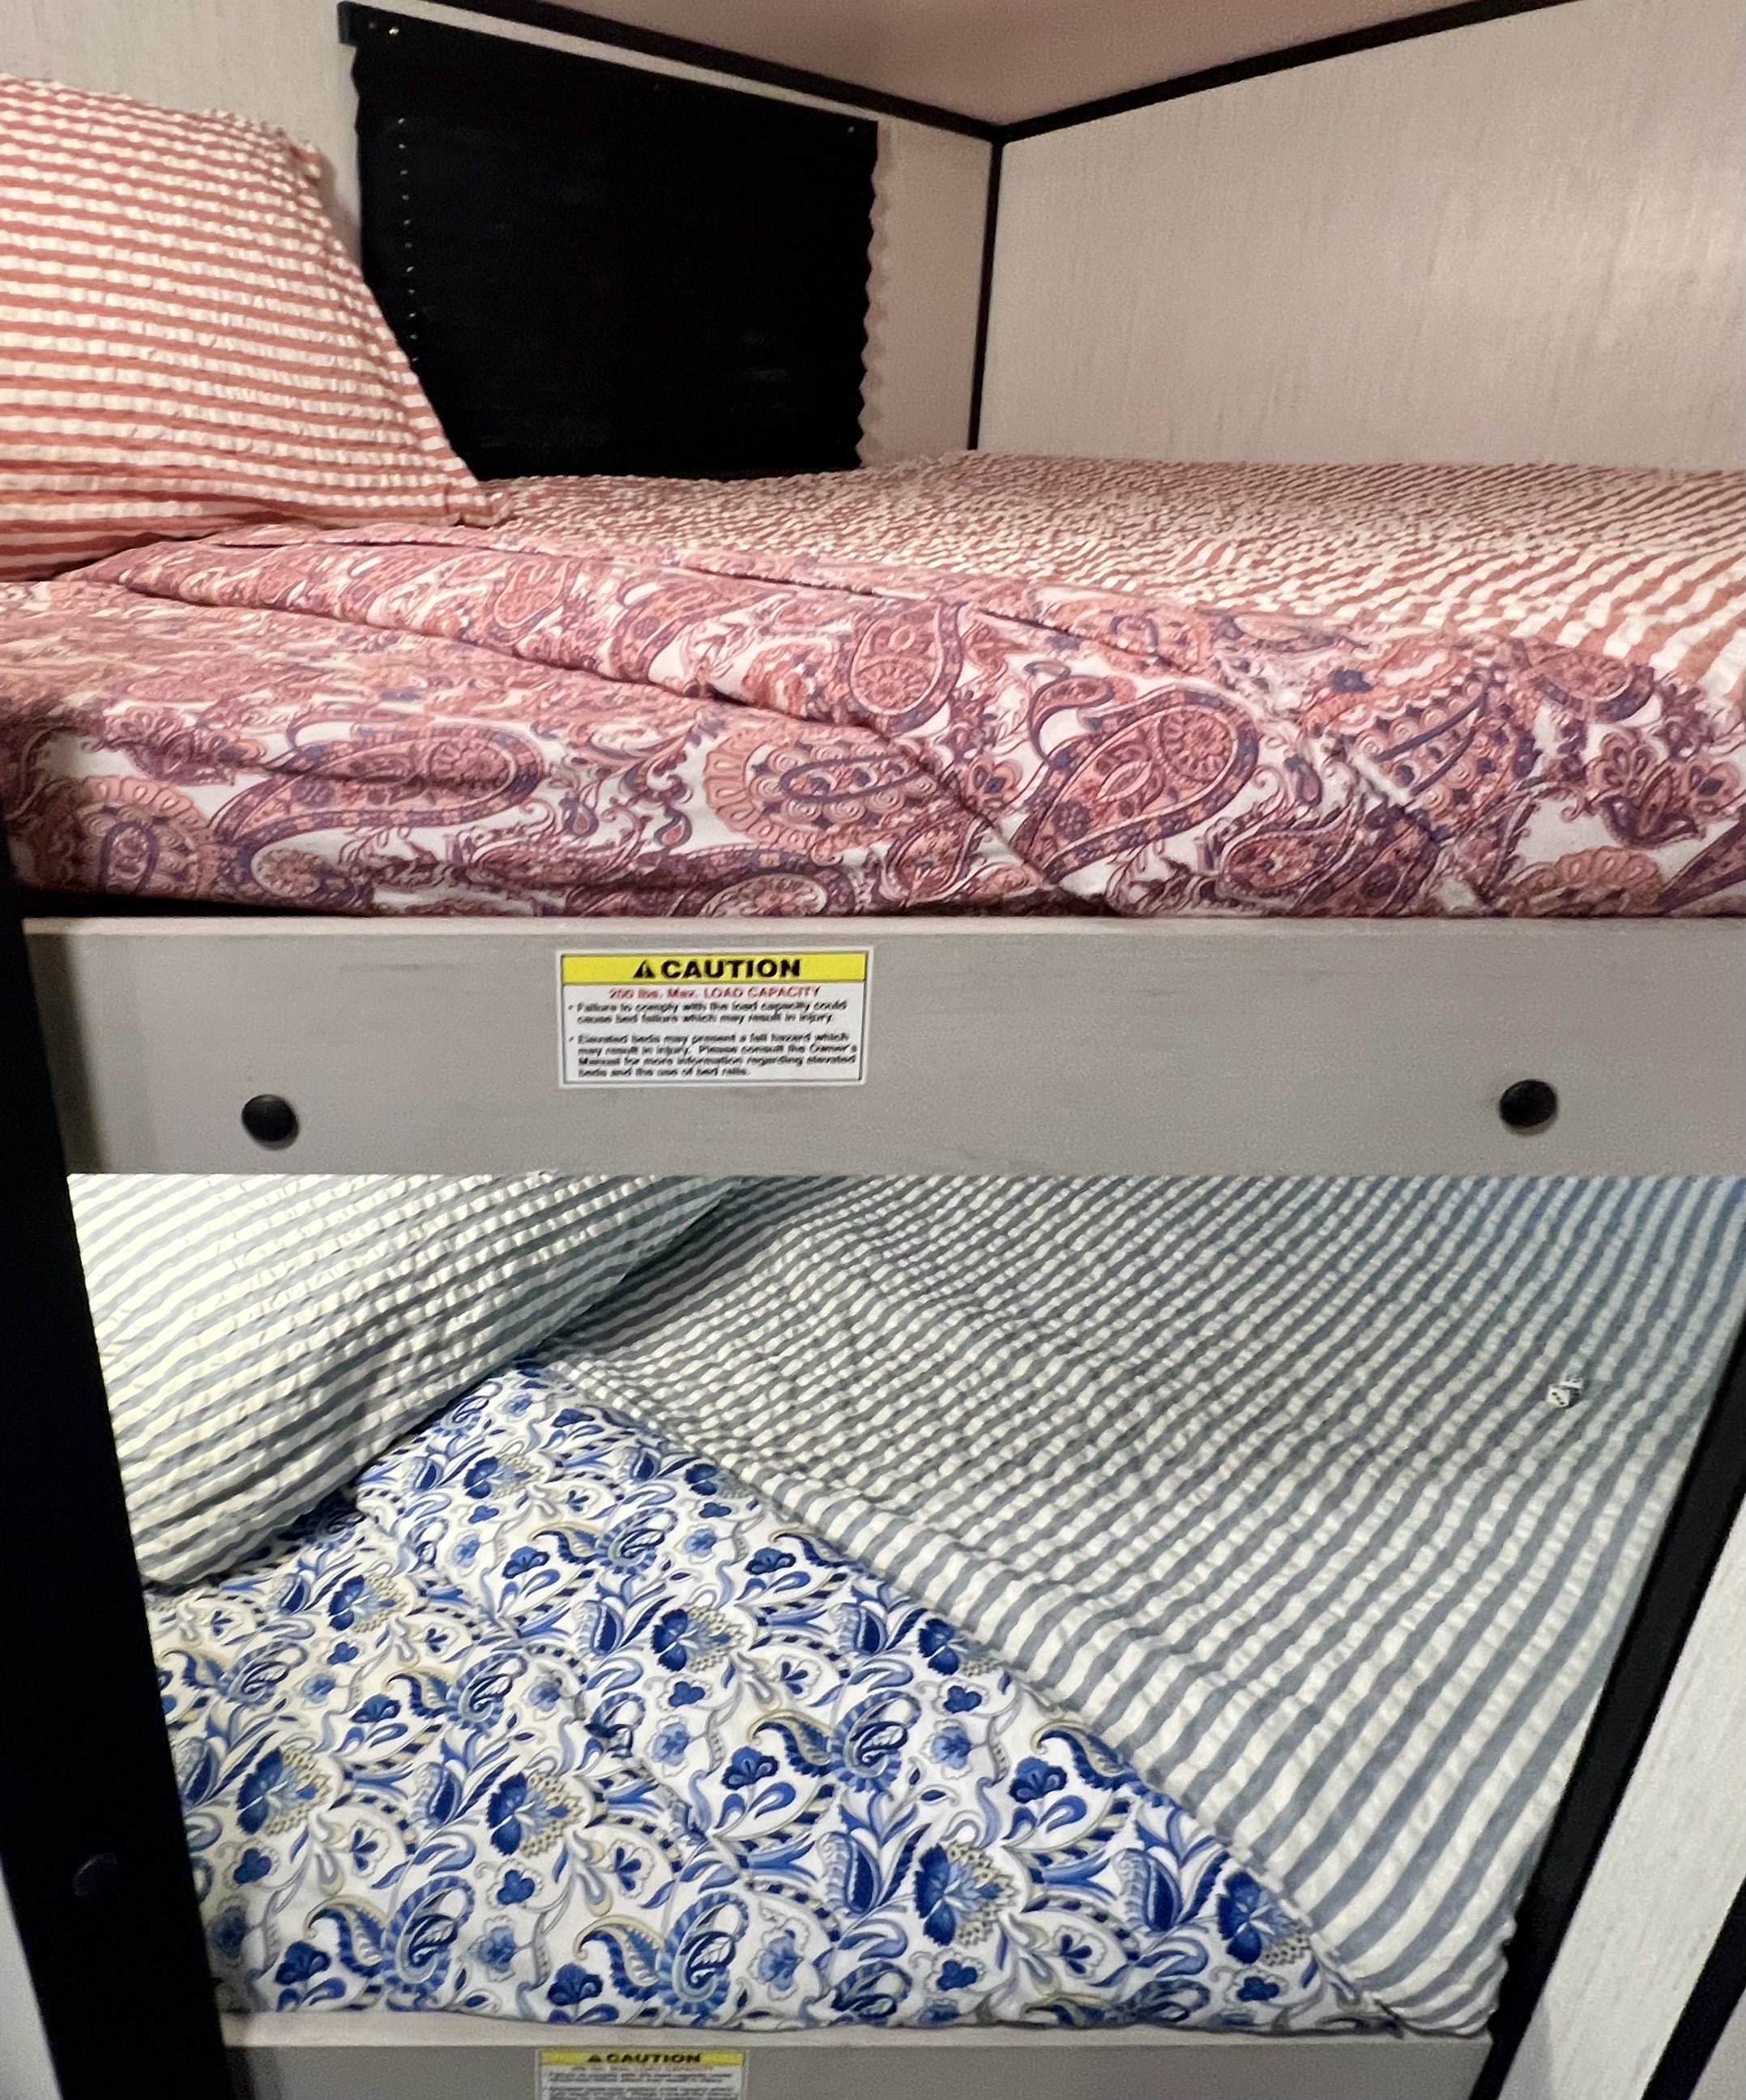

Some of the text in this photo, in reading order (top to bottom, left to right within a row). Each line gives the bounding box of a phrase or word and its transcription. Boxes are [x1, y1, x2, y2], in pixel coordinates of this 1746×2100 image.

[661, 959, 801, 979] CAUTION
[702, 987, 744, 999] LOAD
[747, 985, 822, 998] CAPACITY
[576, 999, 848, 1014] Failure to comply with the load capacity could
[615, 1014, 638, 1024] bed
[641, 1014, 678, 1024] failure
[682, 1013, 717, 1023] which
[719, 1015, 745, 1025] may
[748, 1013, 782, 1023] result
[784, 1014, 796, 1022] in
[631, 1034, 661, 1044] beds
[664, 1035, 689, 1046] may
[691, 1034, 736, 1045] present
[814, 1031, 850, 1042] which
[578, 1048, 603, 1057] may
[605, 1045, 638, 1056] result
[642, 1045, 654, 1055] in
[698, 1044, 737, 1055] Please
[741, 1044, 784, 1054] consult
[787, 1044, 805, 1053] the
[643, 1057, 674, 1065] more
[677, 1055, 743, 1065] information
[746, 1055, 804, 1068] regarding
[610, 1068, 633, 1078] and
[635, 1067, 654, 1077] the
[681, 1067, 693, 1077] of
[696, 1067, 719, 1077] bed
[607, 2053, 702, 2064] CAUTION
